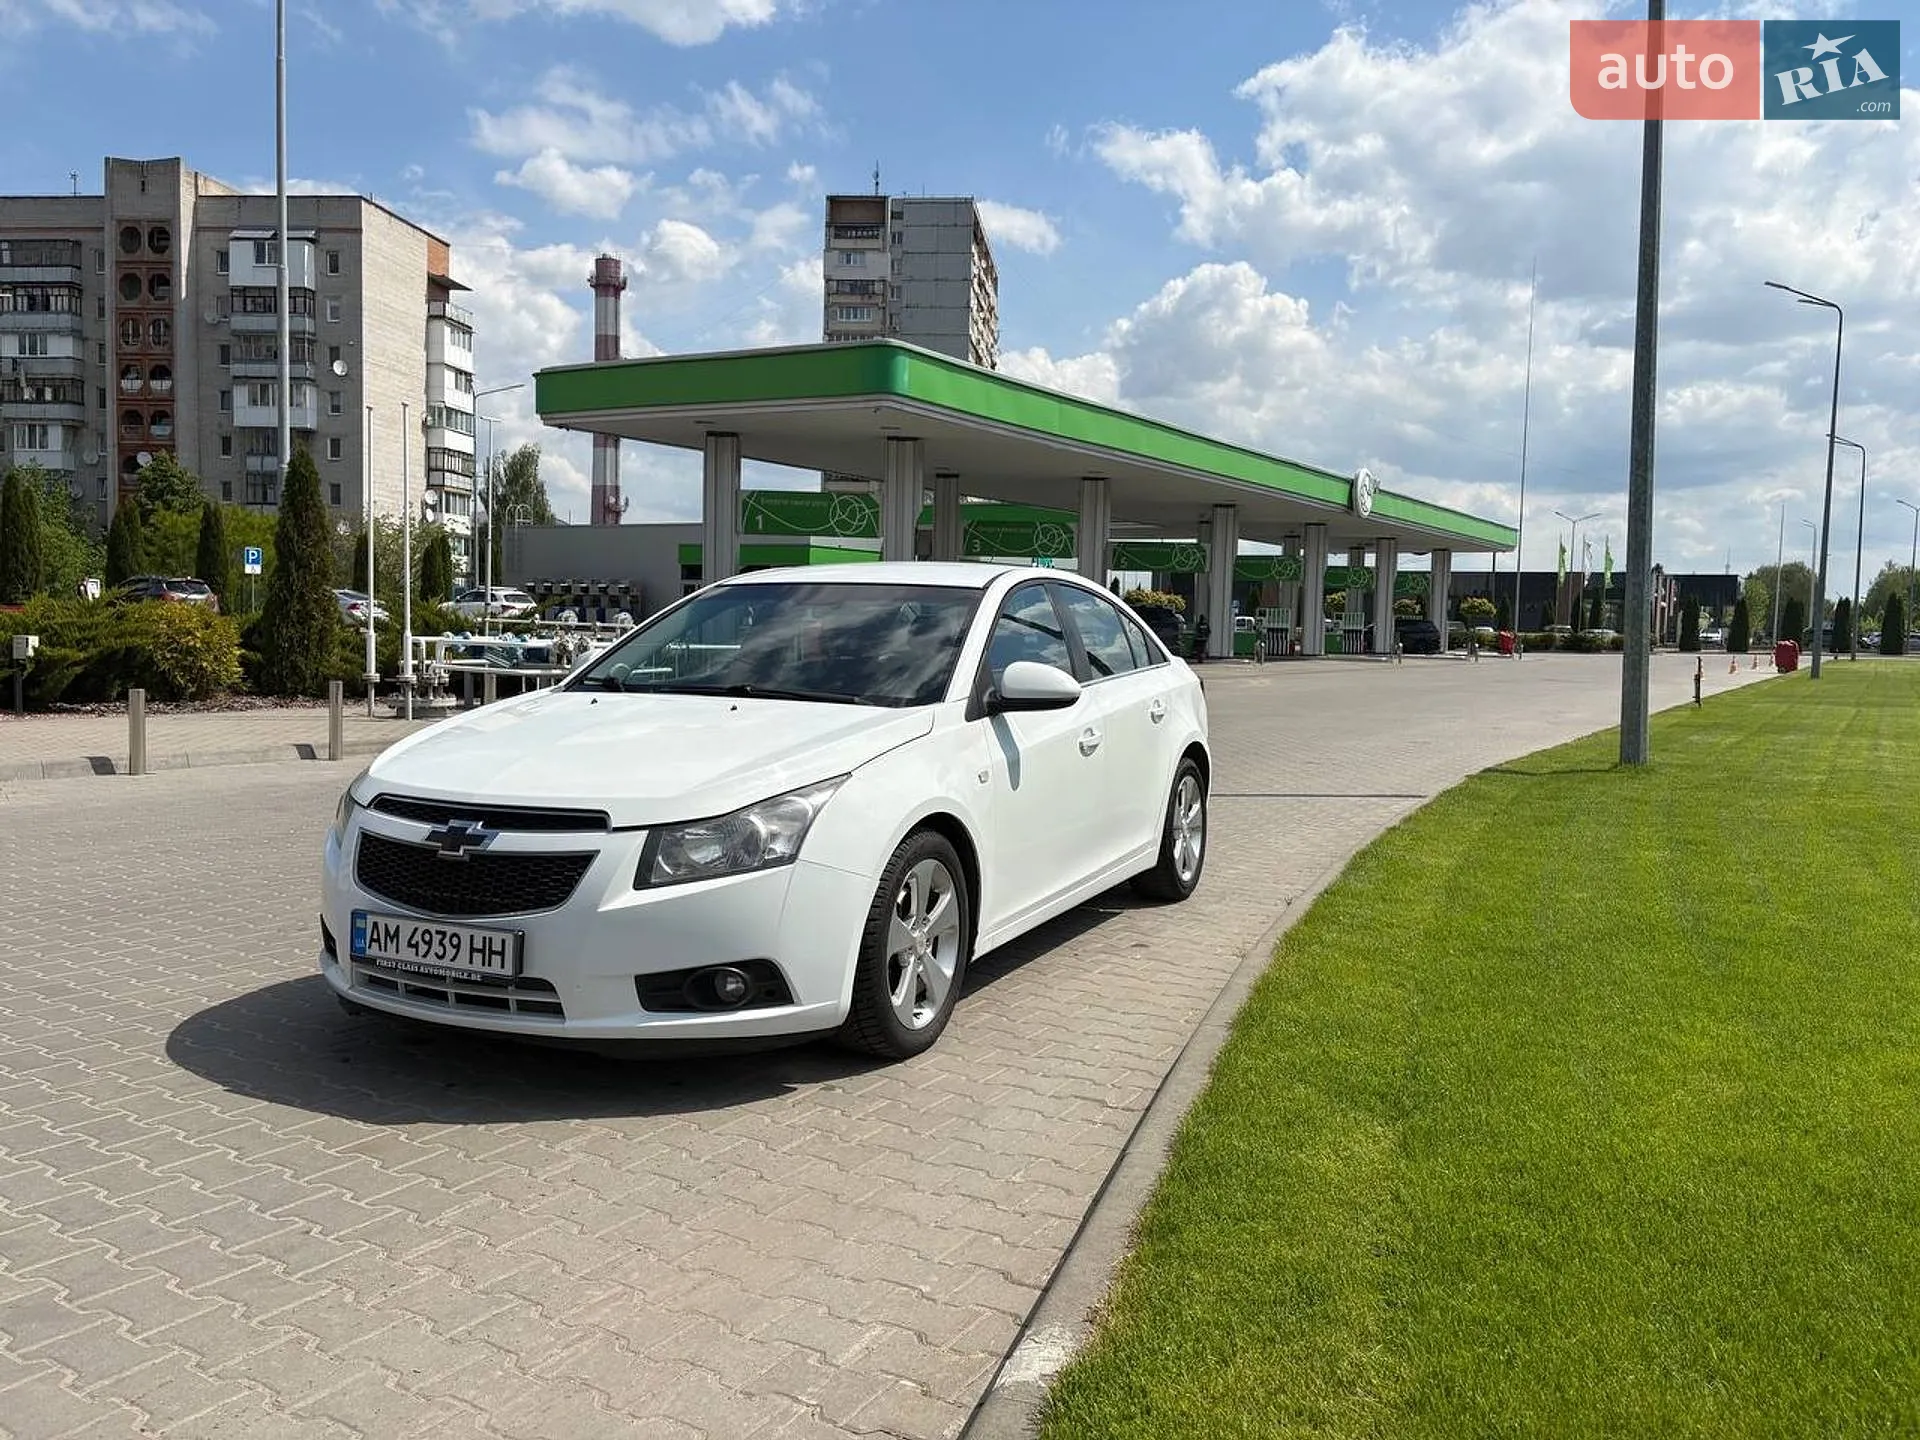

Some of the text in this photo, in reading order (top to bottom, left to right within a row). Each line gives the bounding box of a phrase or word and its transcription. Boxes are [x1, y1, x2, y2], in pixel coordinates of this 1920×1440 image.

[755, 514, 763, 529] 1
[972, 540, 980, 552] 3
[249, 550, 258, 564] P
[368, 920, 506, 969] AM 4939 HH
